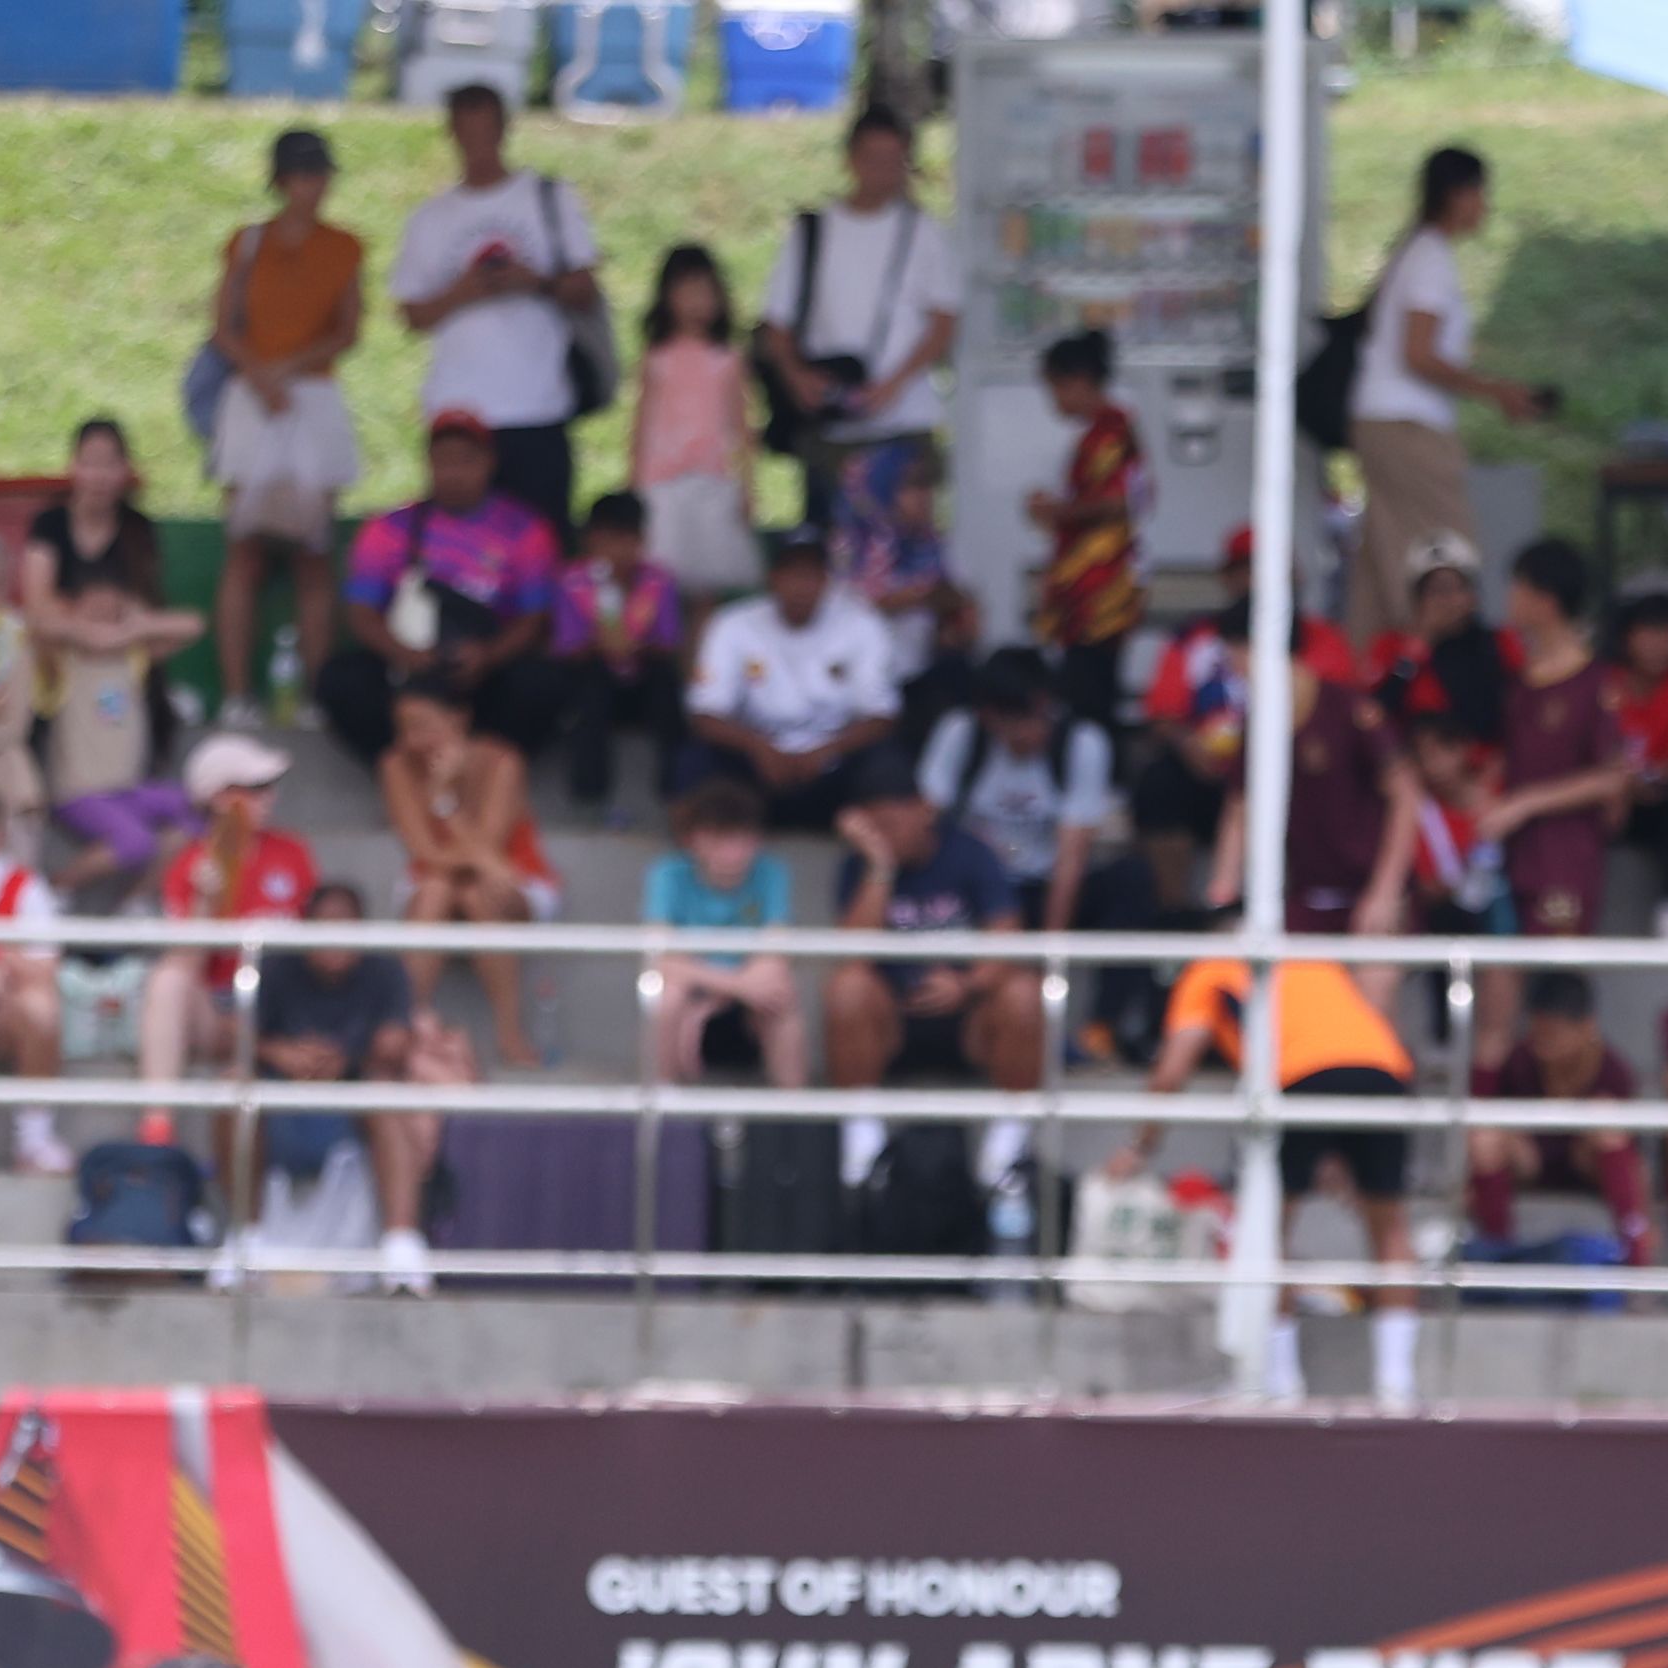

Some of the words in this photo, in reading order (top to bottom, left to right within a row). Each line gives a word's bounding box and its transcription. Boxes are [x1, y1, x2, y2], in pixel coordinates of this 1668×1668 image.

[586, 1554, 775, 1615] GUEST
[778, 1557, 863, 1616] OF
[866, 1558, 1122, 1618] HONOUR
